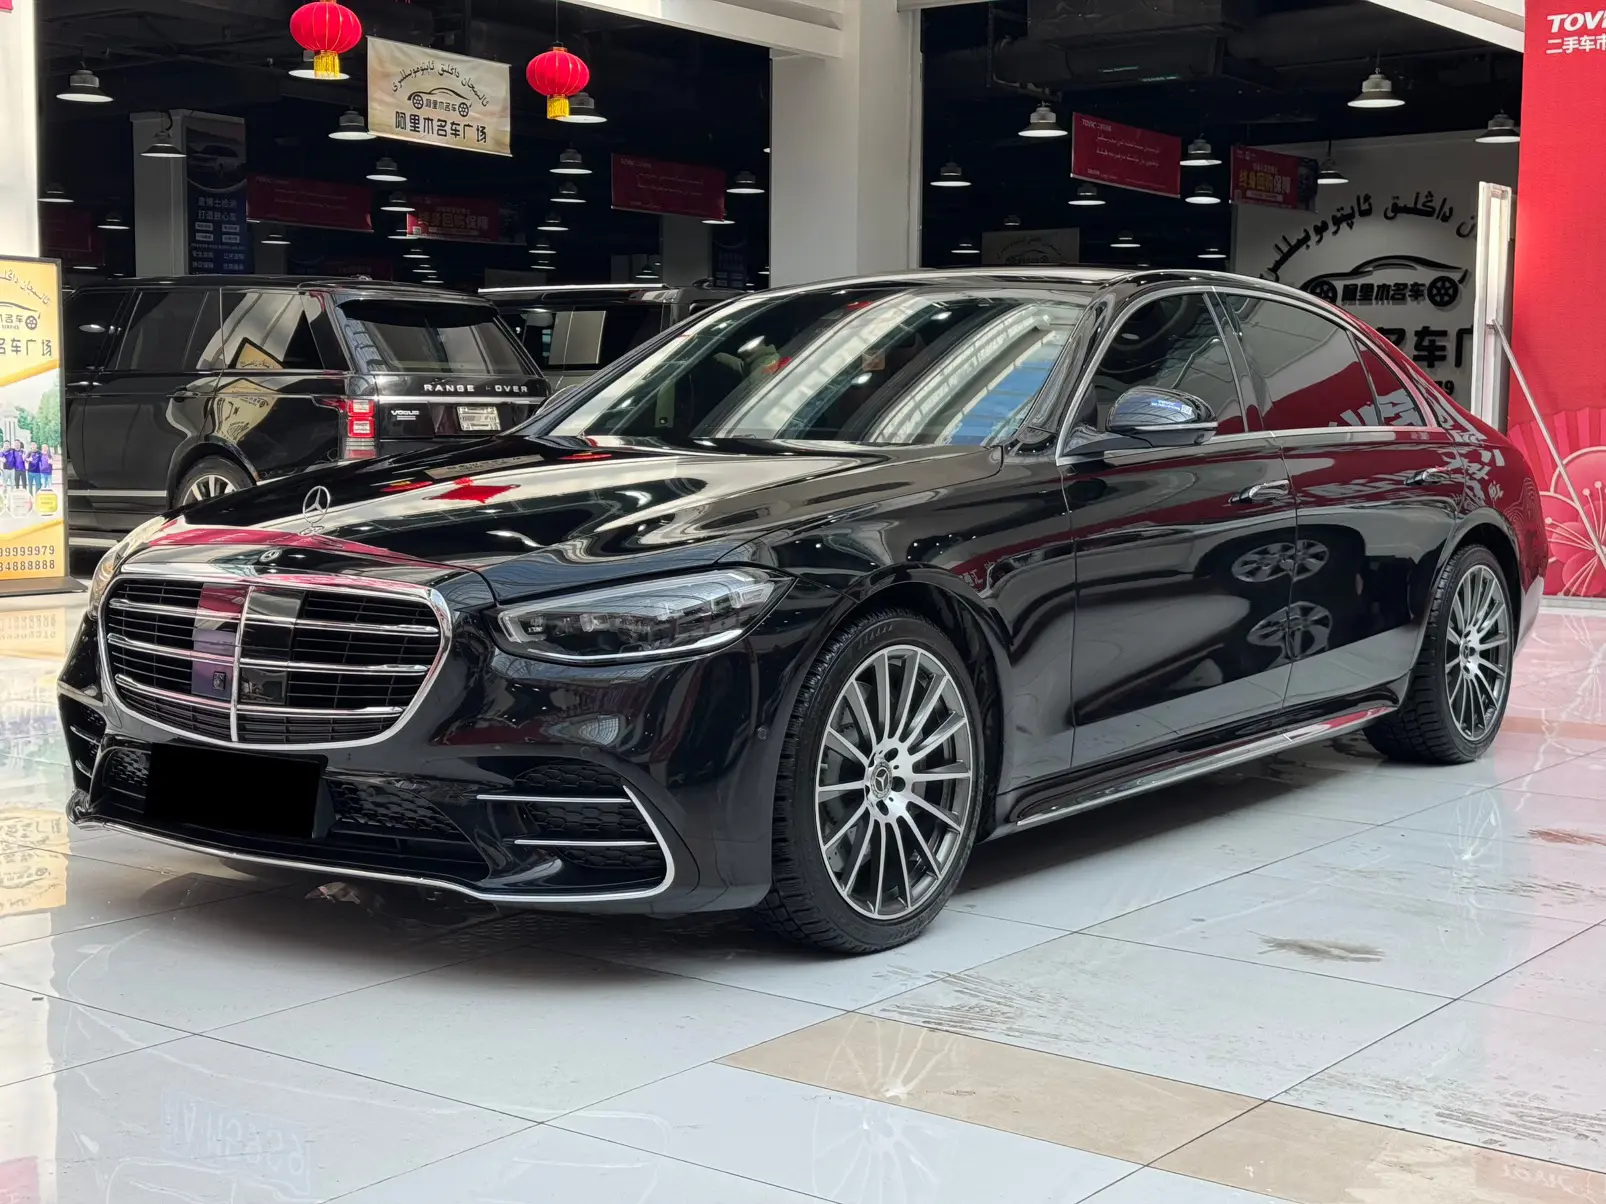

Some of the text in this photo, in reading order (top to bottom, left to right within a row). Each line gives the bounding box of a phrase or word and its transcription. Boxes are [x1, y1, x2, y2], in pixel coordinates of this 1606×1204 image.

[1546, 33, 1606, 54] 二手车市
[395, 110, 487, 143] 阿里木名车广场
[424, 384, 475, 393] RANGE
